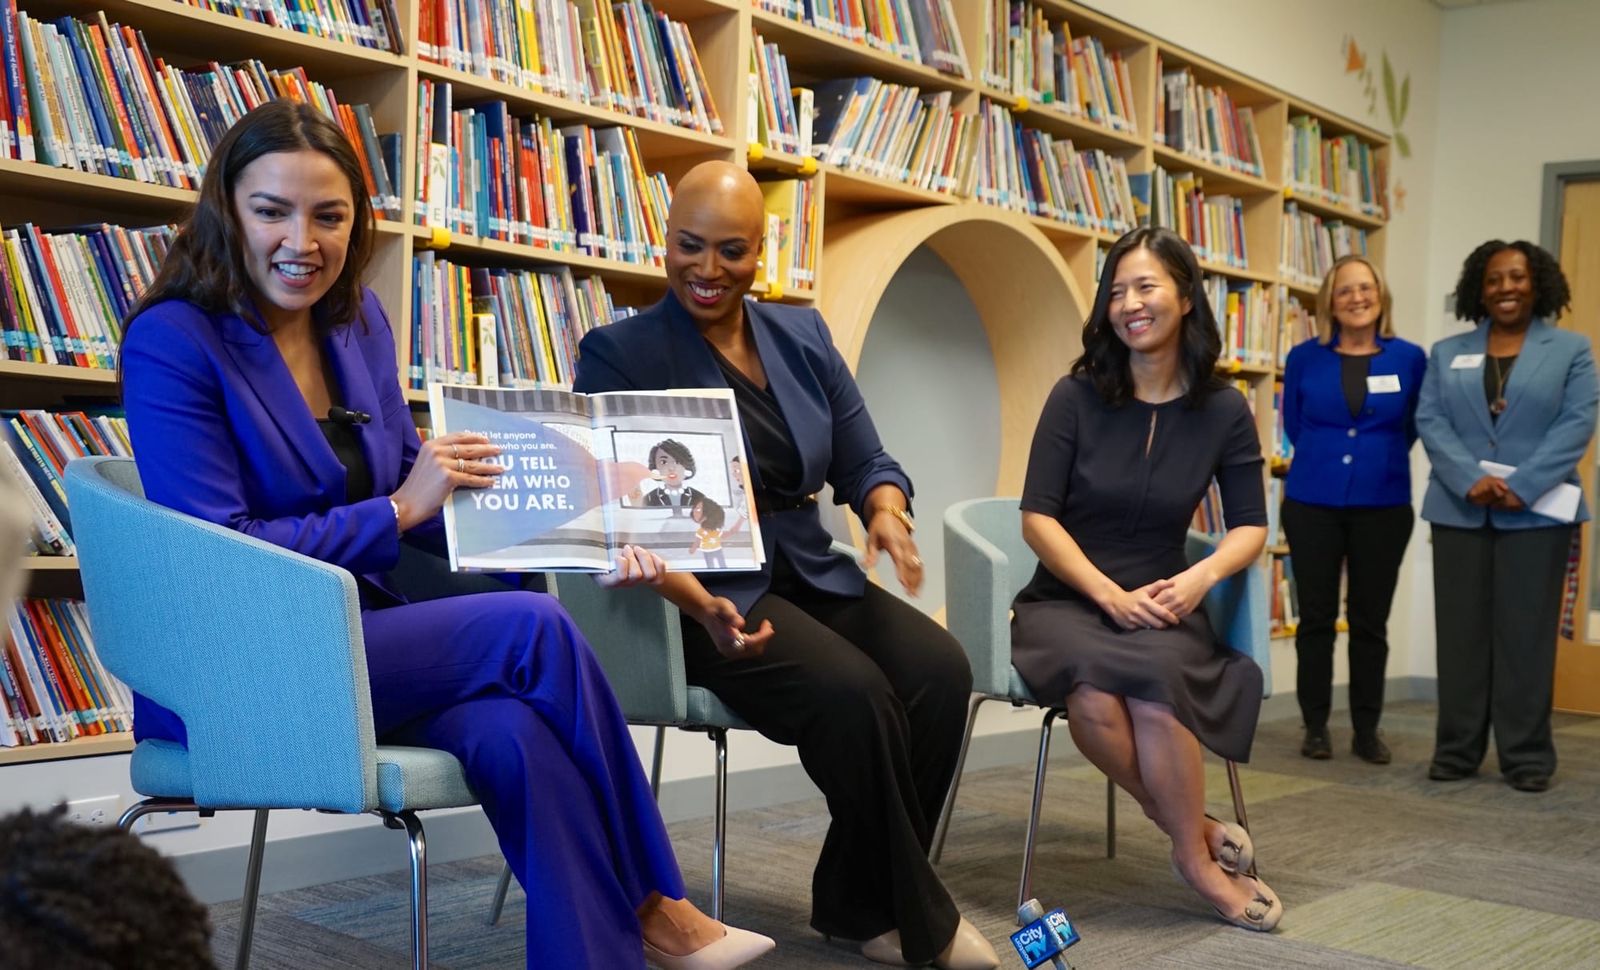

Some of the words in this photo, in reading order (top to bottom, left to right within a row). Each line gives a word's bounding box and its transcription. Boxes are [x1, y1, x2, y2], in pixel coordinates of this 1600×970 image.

[434, 208, 441, 221] E
[503, 432, 536, 440] anyone
[522, 443, 538, 451] you
[520, 456, 557, 470] TELL
[523, 475, 570, 488] WHO
[471, 493, 519, 510] YOU
[526, 494, 574, 510] ARE.
[1050, 912, 1066, 926] City
[1020, 926, 1043, 945] City
[1055, 920, 1072, 940] TV
[1015, 937, 1032, 965] boston
[1025, 934, 1046, 958] TV
